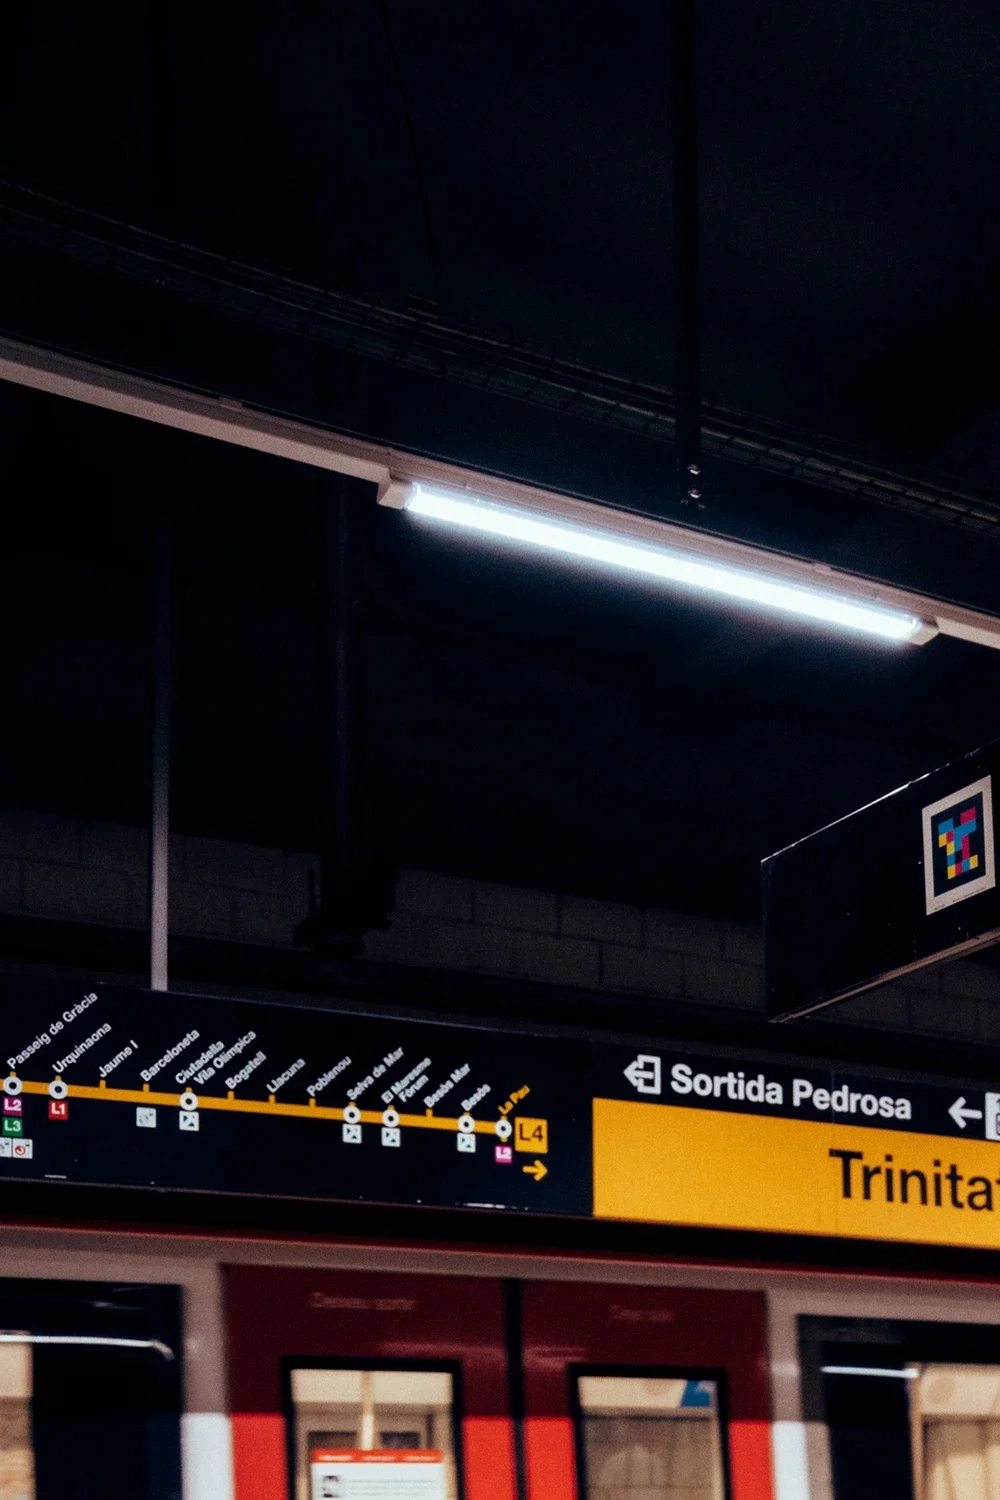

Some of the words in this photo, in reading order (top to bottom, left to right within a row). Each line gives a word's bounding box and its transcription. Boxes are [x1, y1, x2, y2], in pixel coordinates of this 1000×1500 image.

[7, 1033, 51, 1069] Passeig
[49, 1021, 64, 1035] de
[62, 993, 98, 1022] Gràcia
[52, 1022, 112, 1073] Urquinaona
[99, 1046, 133, 1077] Jaume
[129, 1039, 139, 1049] I
[140, 1030, 200, 1082] Barceloneta
[175, 1041, 225, 1084] Ciutadella
[225, 1051, 267, 1090] Bogatell
[346, 1075, 374, 1101] Selva
[372, 1064, 387, 1078] de
[383, 1047, 404, 1067] Mar
[450, 1063, 471, 1083] Mar
[193, 1066, 216, 1085] Vila
[266, 1058, 306, 1093] Llacuna
[306, 1056, 352, 1097] Poblenou
[670, 1063, 784, 1105] Sortida
[792, 1078, 912, 1121] Pedrosa
[4, 1098, 22, 1112] L2
[51, 1102, 66, 1115] L1
[381, 1090, 395, 1104] El
[498, 1101, 514, 1115] La
[509, 1085, 531, 1105] Pau
[4, 1120, 21, 1132] L3
[519, 1123, 544, 1142] L4
